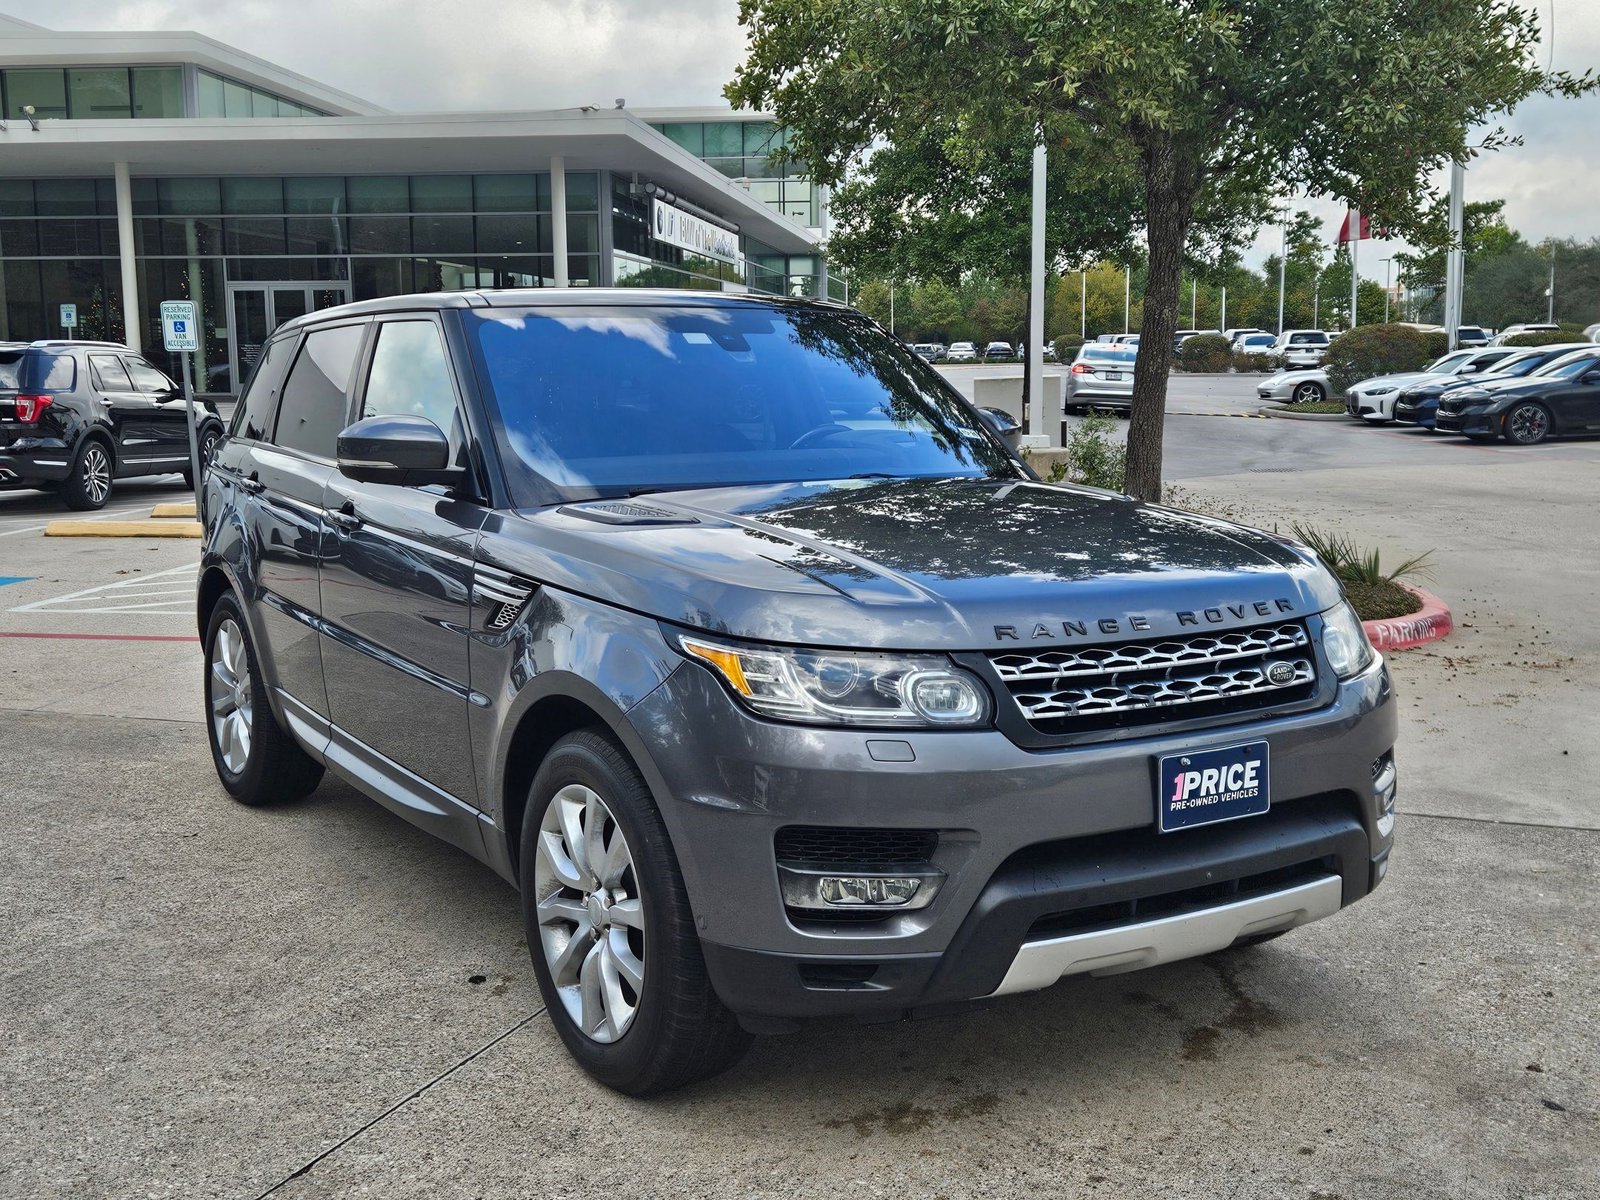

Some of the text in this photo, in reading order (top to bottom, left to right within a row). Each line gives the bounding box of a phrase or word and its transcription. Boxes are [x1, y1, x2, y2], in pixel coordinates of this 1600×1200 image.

[993, 597, 1295, 641] RANGE ROVER
[1375, 618, 1436, 646] PARKING
[1273, 667, 1288, 675] LAND
[1172, 760, 1261, 802] 1PRICE
[1170, 787, 1259, 812] PRE-OWNED VEHICLES
